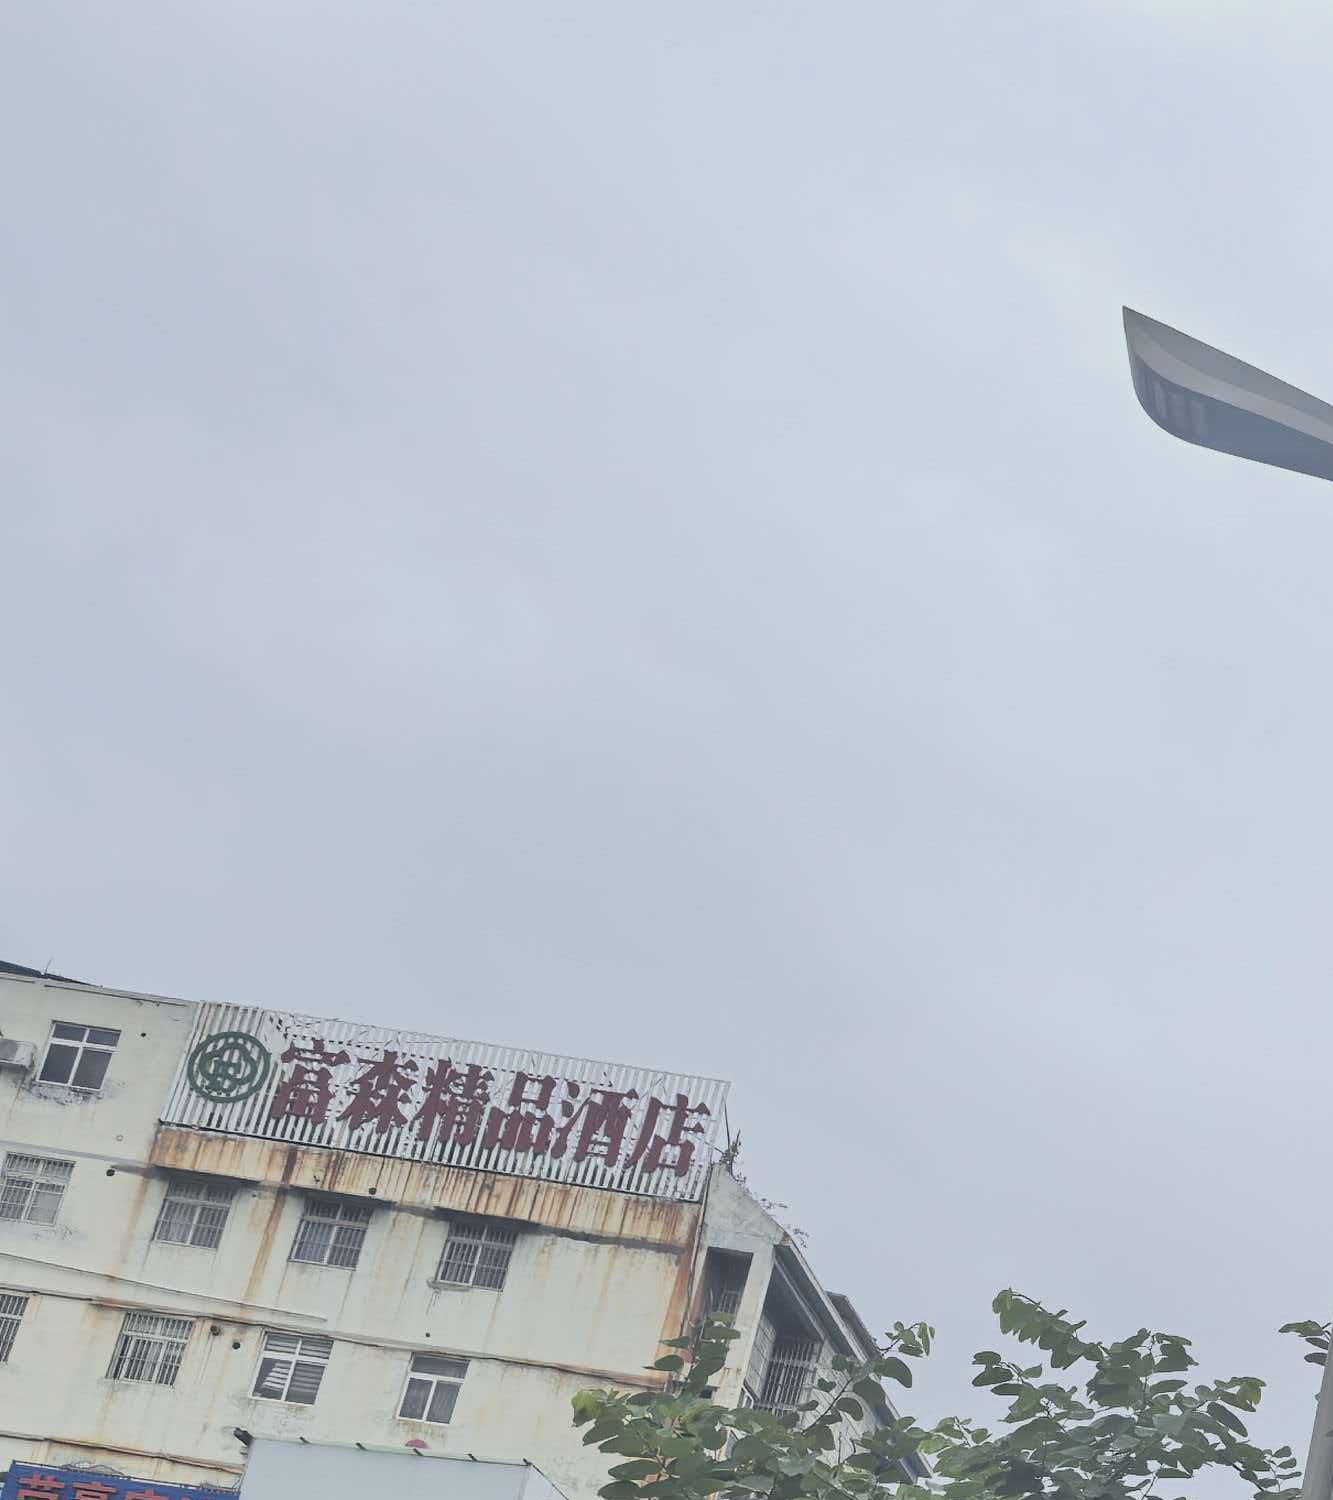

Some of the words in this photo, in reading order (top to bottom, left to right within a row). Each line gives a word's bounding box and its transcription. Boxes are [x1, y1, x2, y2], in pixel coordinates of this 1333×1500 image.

[270, 1039, 711, 1177] 富森精品酒店
